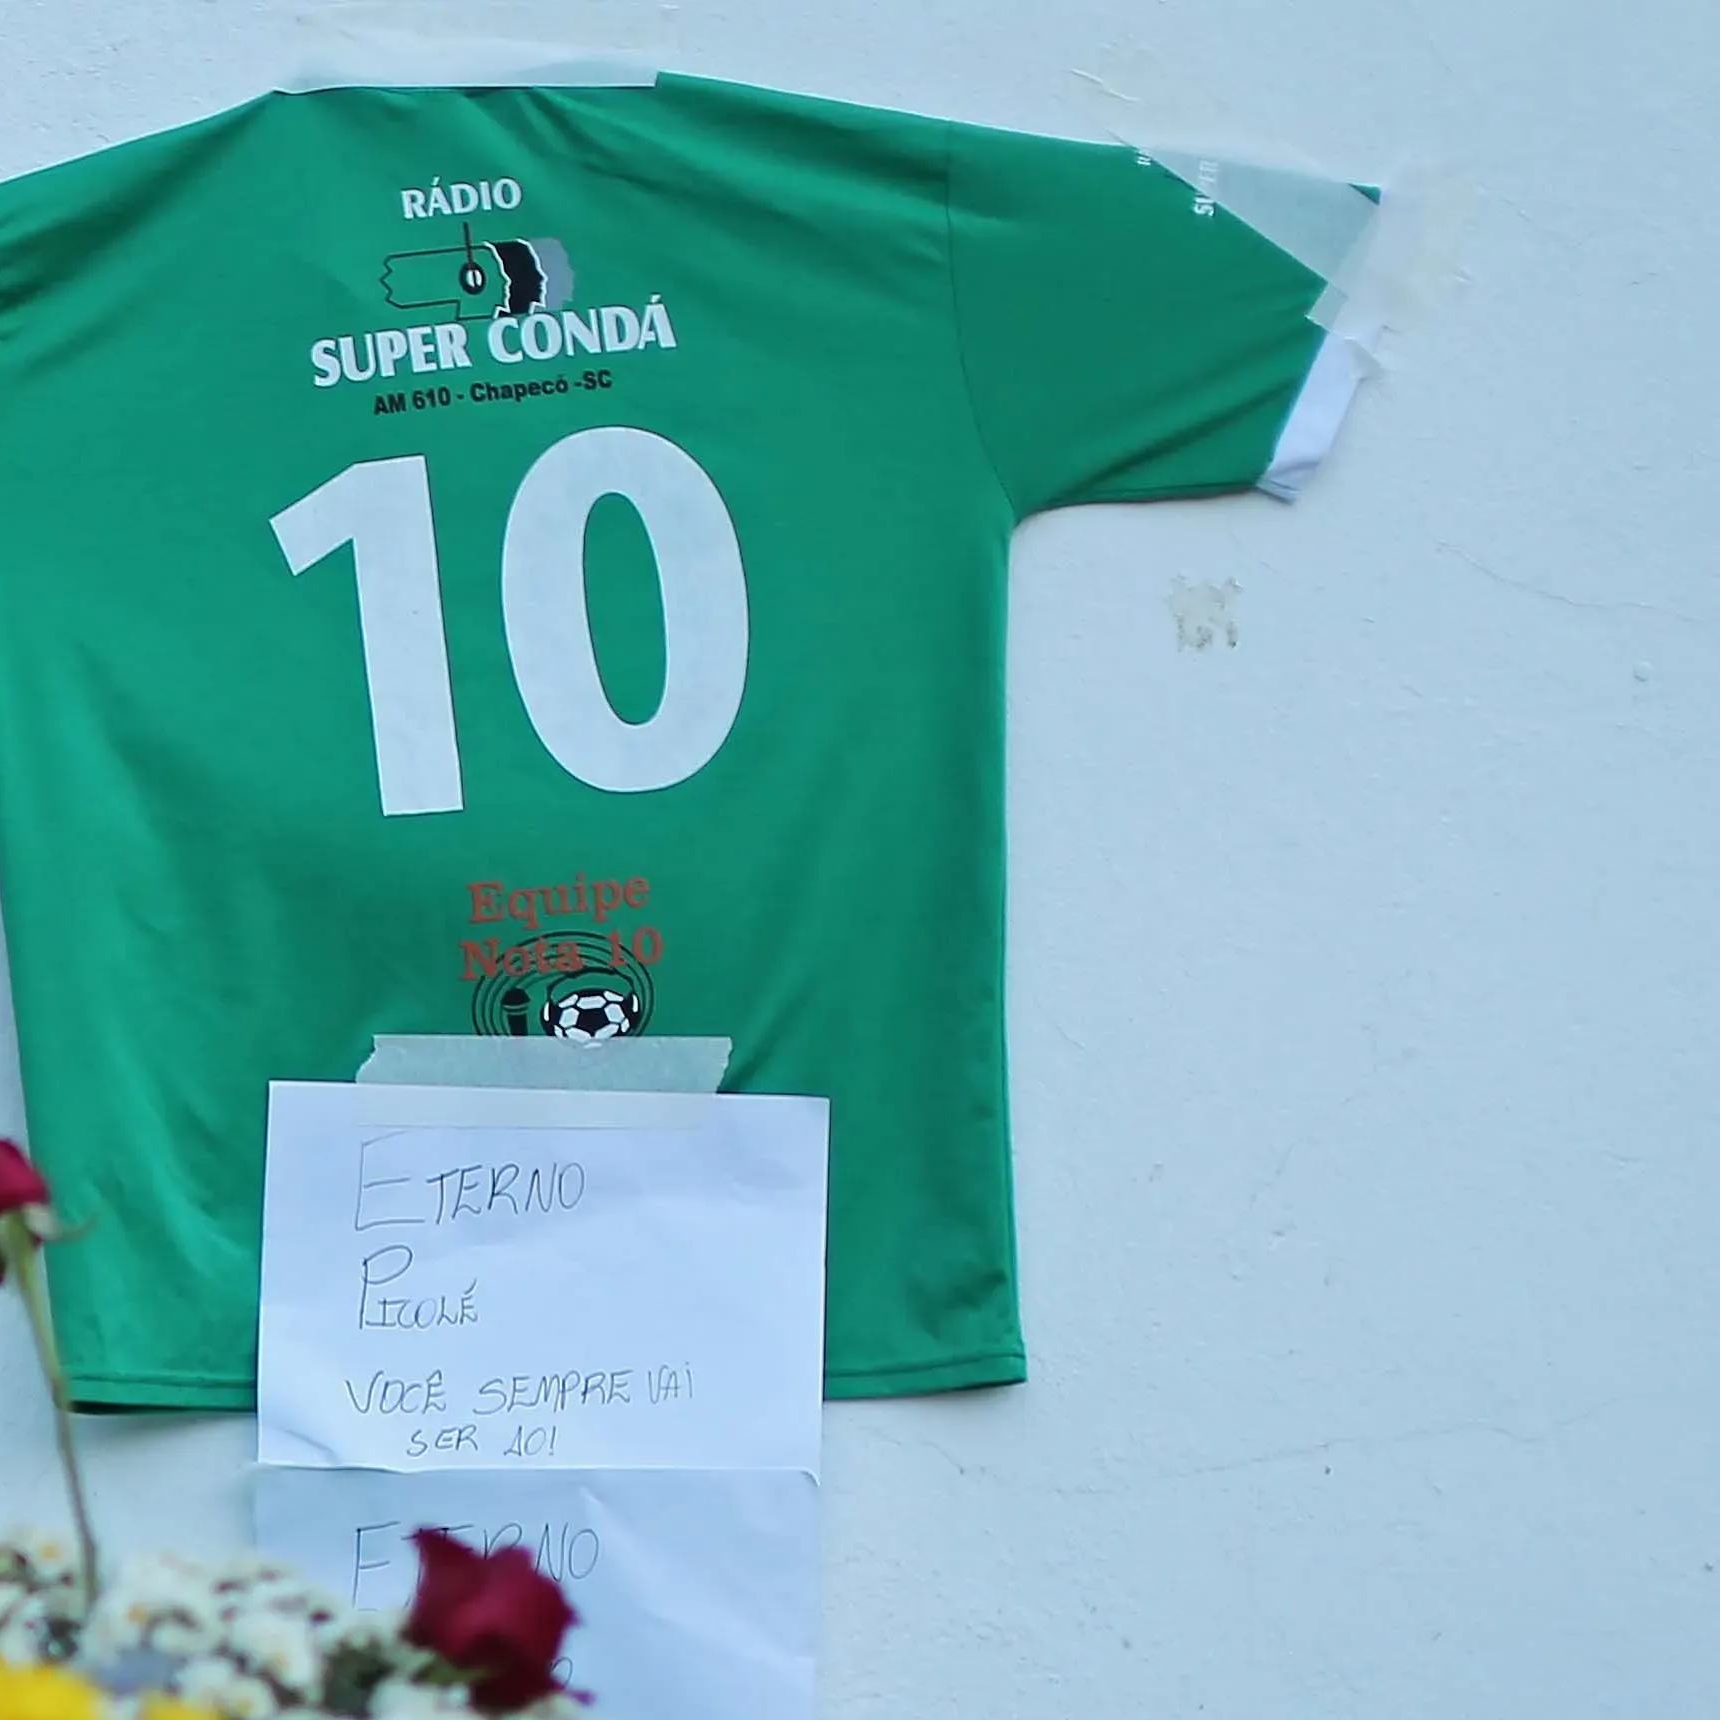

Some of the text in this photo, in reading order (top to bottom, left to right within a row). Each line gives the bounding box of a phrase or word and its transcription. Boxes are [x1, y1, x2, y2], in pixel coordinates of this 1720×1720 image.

[400, 175, 523, 220] RÁDIO
[310, 294, 679, 388] SUPER CONDÁ
[373, 391, 407, 416] AM
[412, 386, 452, 412] 610
[471, 372, 570, 406] Chapecó
[268, 424, 751, 818] 10
[466, 871, 651, 931] Equipe
[459, 925, 665, 981] Nota 10
[354, 1129, 587, 1233] ETERNO
[345, 1367, 446, 1417] VOCÊ
[472, 1369, 634, 1416] SEMPRE
[406, 1423, 479, 1459] SER
